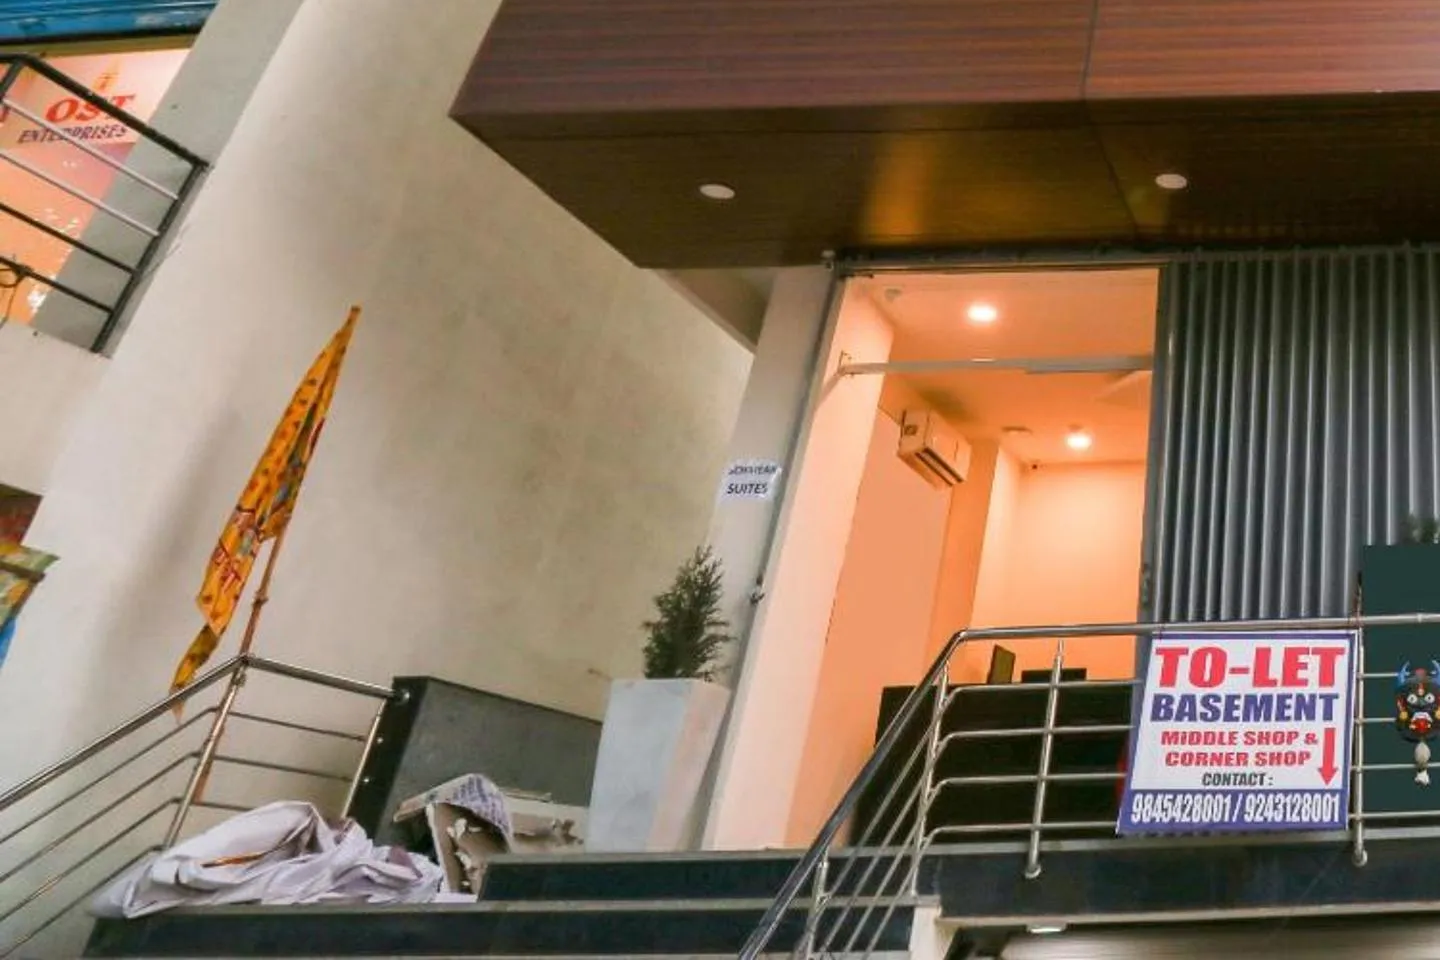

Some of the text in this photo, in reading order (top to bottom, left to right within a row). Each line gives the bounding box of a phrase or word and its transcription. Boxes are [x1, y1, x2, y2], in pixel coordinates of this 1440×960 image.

[727, 483, 768, 495] SUITES
[1155, 646, 1345, 688] TO-LET
[1150, 693, 1339, 723] BASEMENT
[1161, 731, 1318, 746] MIDDLE SHOP &
[1165, 751, 1311, 767] CORNER SHOP
[1131, 793, 1230, 823] 9845428001
[1243, 793, 1339, 823] 9243128001
